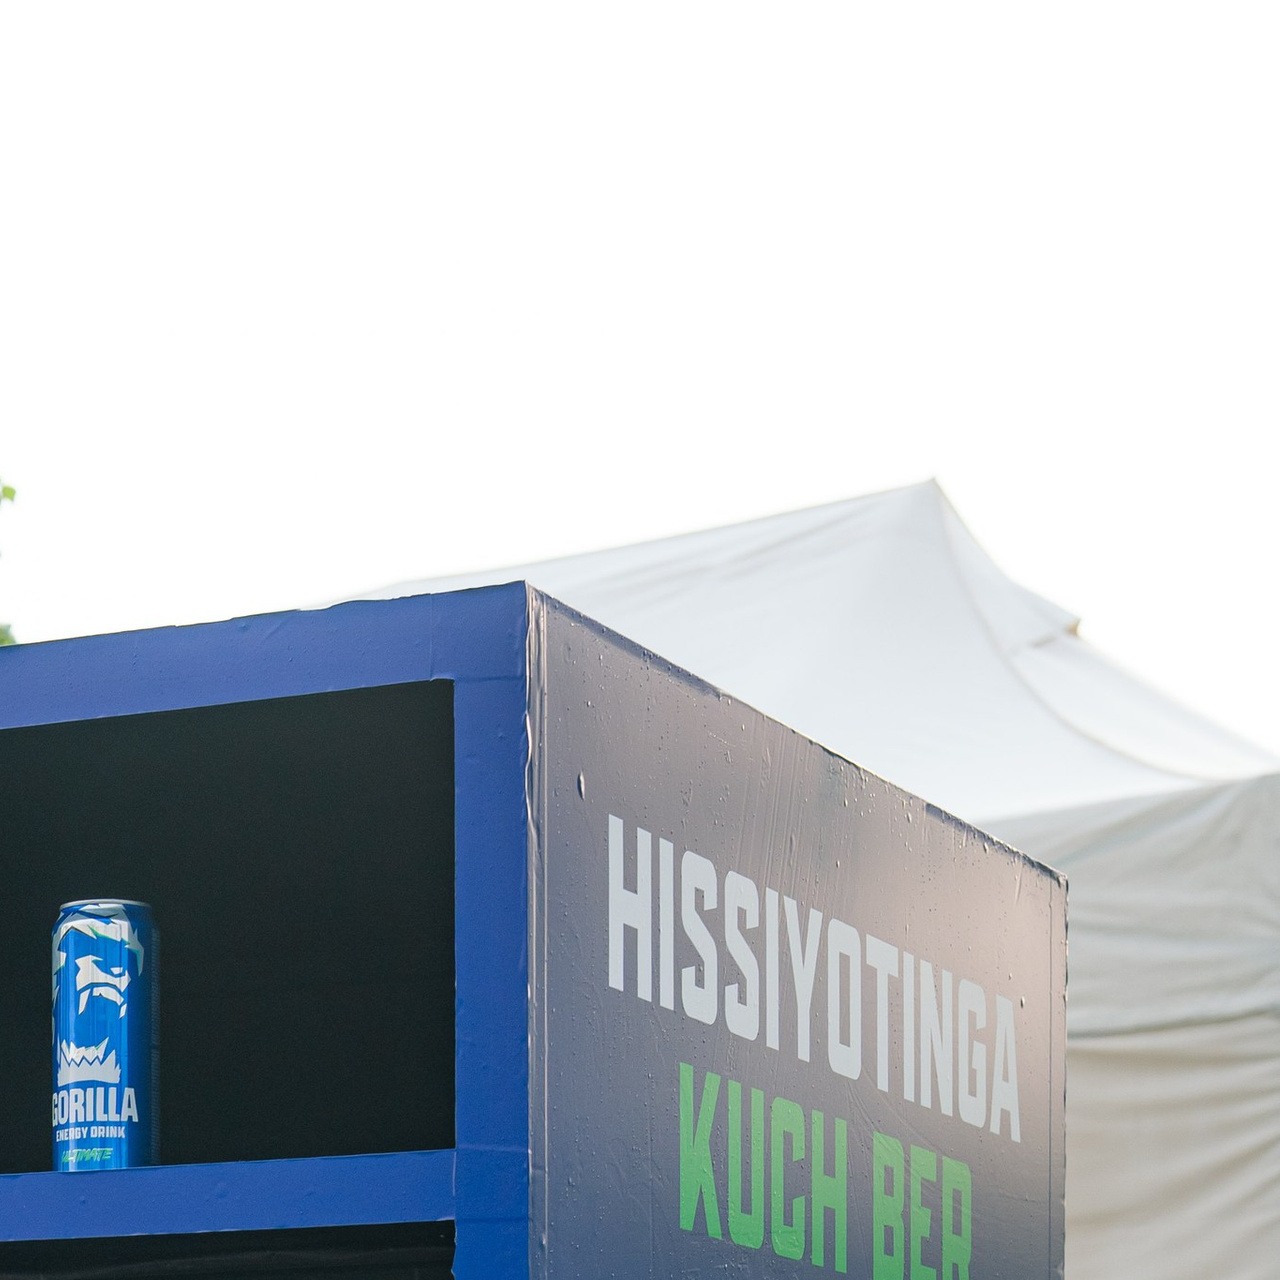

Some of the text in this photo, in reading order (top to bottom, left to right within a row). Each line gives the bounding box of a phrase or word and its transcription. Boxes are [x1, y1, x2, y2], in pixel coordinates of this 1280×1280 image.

[608, 814, 1021, 1143] HISSIYOTINGA
[52, 1087, 138, 1127] GORILLA
[56, 1126, 125, 1142] ENERGY DRINK
[62, 1148, 113, 1163] ULTIMATE
[679, 1062, 847, 1273] KUCH
